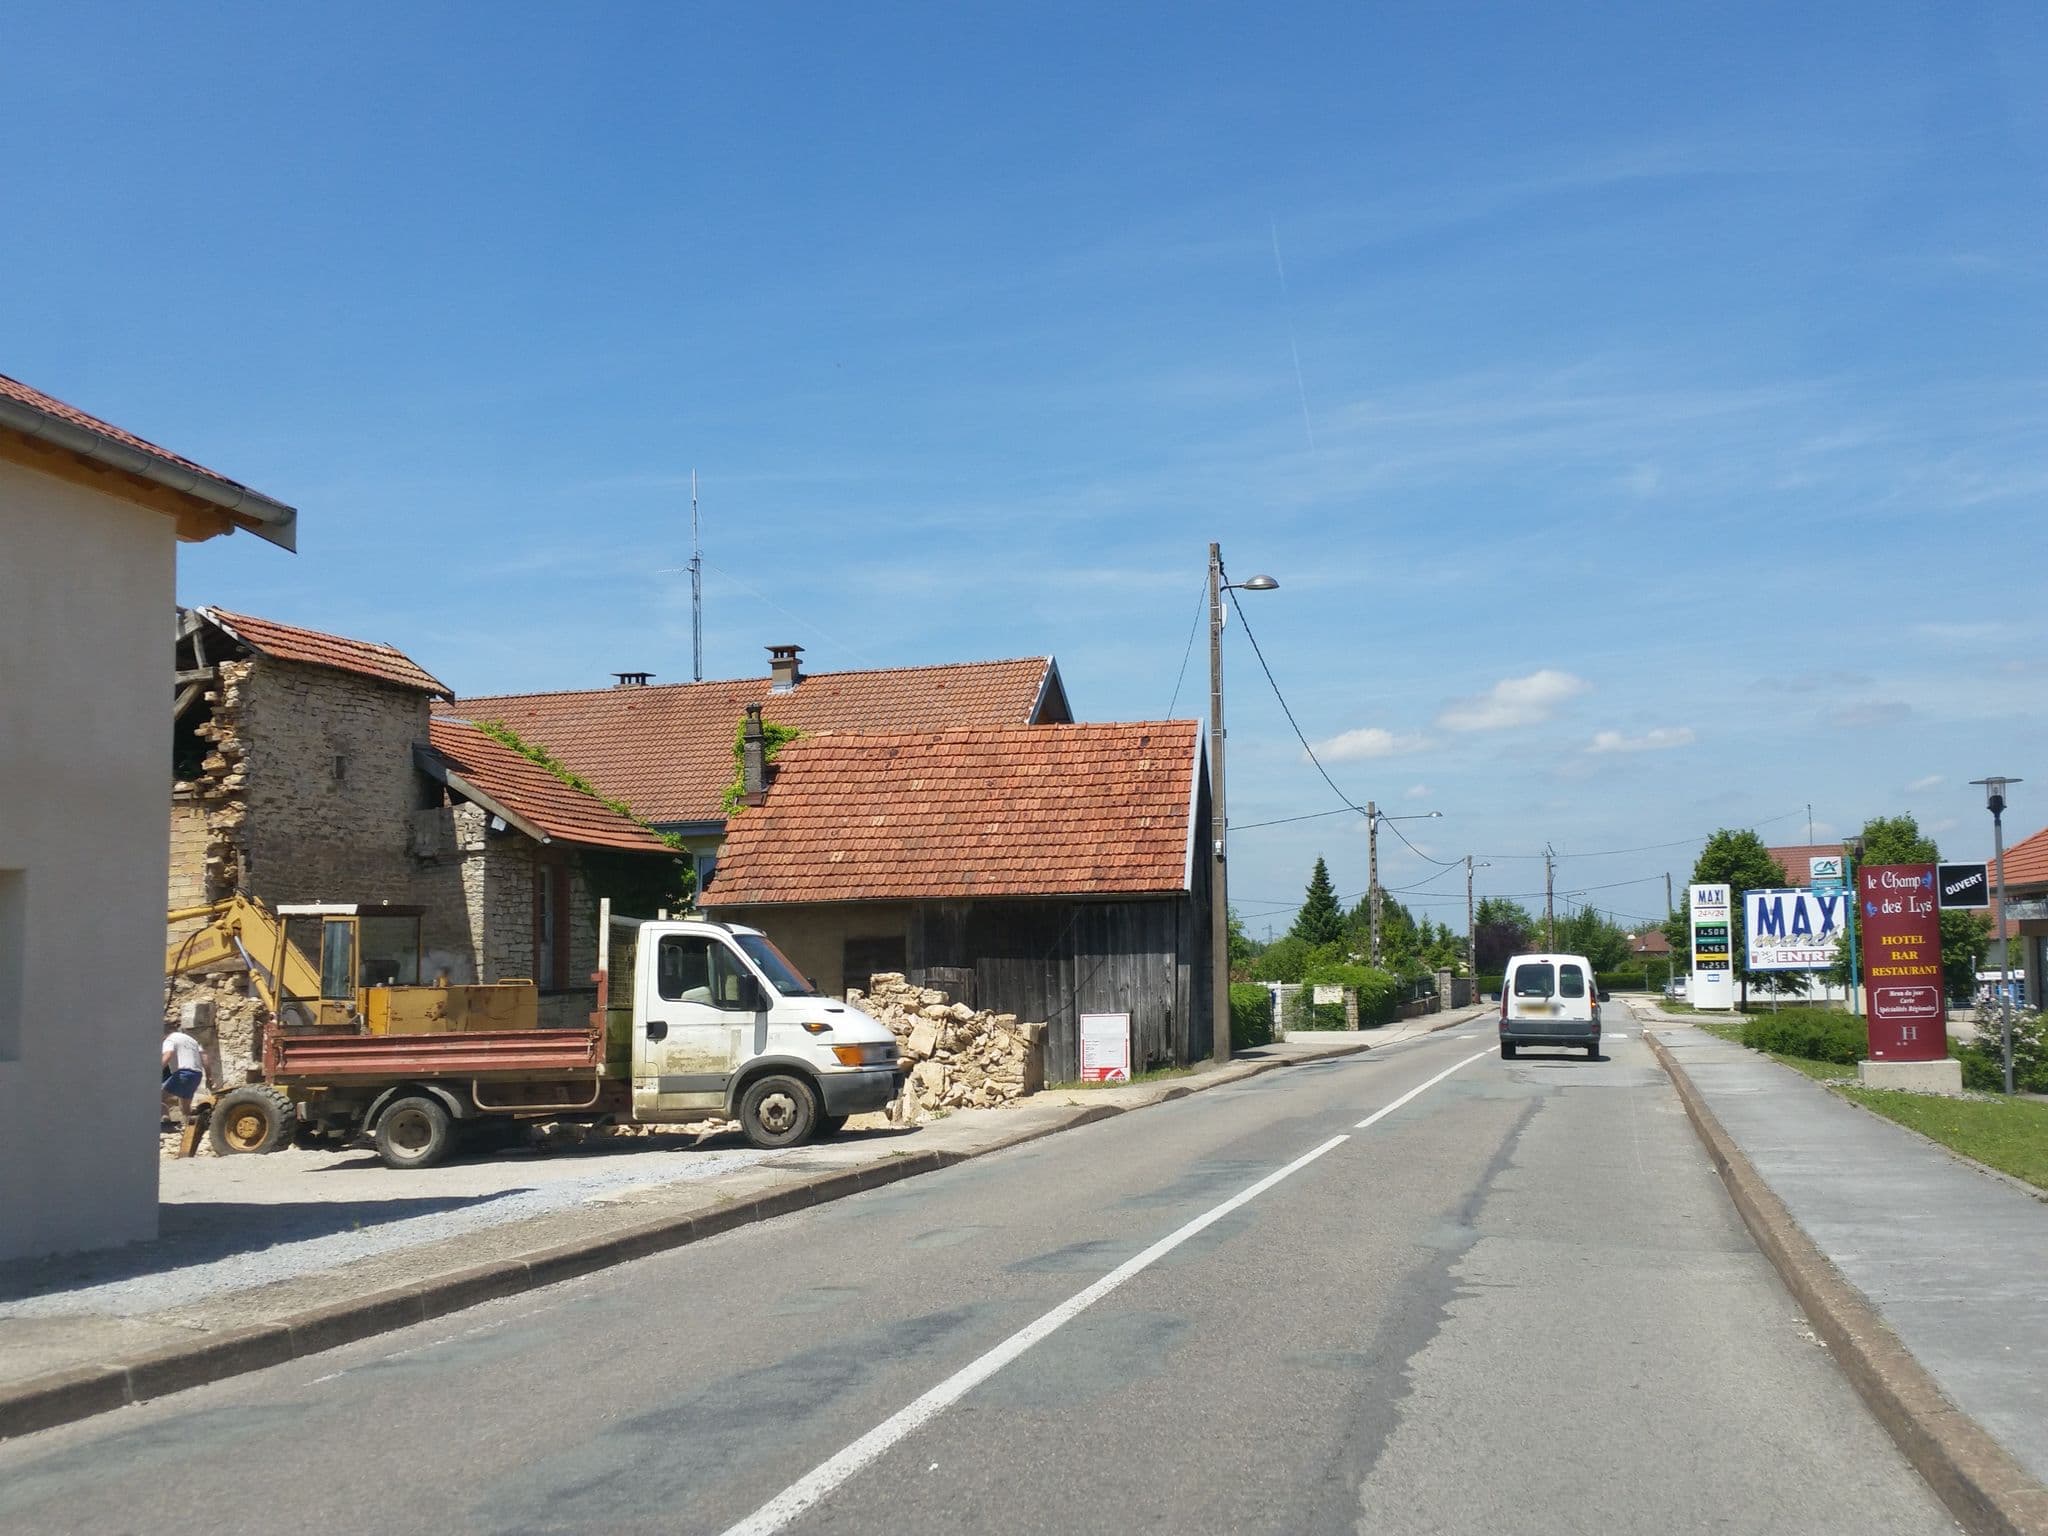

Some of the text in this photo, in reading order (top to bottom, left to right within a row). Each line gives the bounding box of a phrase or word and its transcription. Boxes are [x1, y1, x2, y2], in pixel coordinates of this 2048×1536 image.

[1867, 871, 1921, 894] le Champ
[1945, 873, 1983, 895] OUVERT
[1698, 890, 1724, 903] MAXI
[1882, 896, 1934, 918] des Lys
[1881, 936, 1926, 945] HOTEL
[1891, 951, 1919, 960] BAR
[1872, 966, 1938, 976] RESTAURANT
